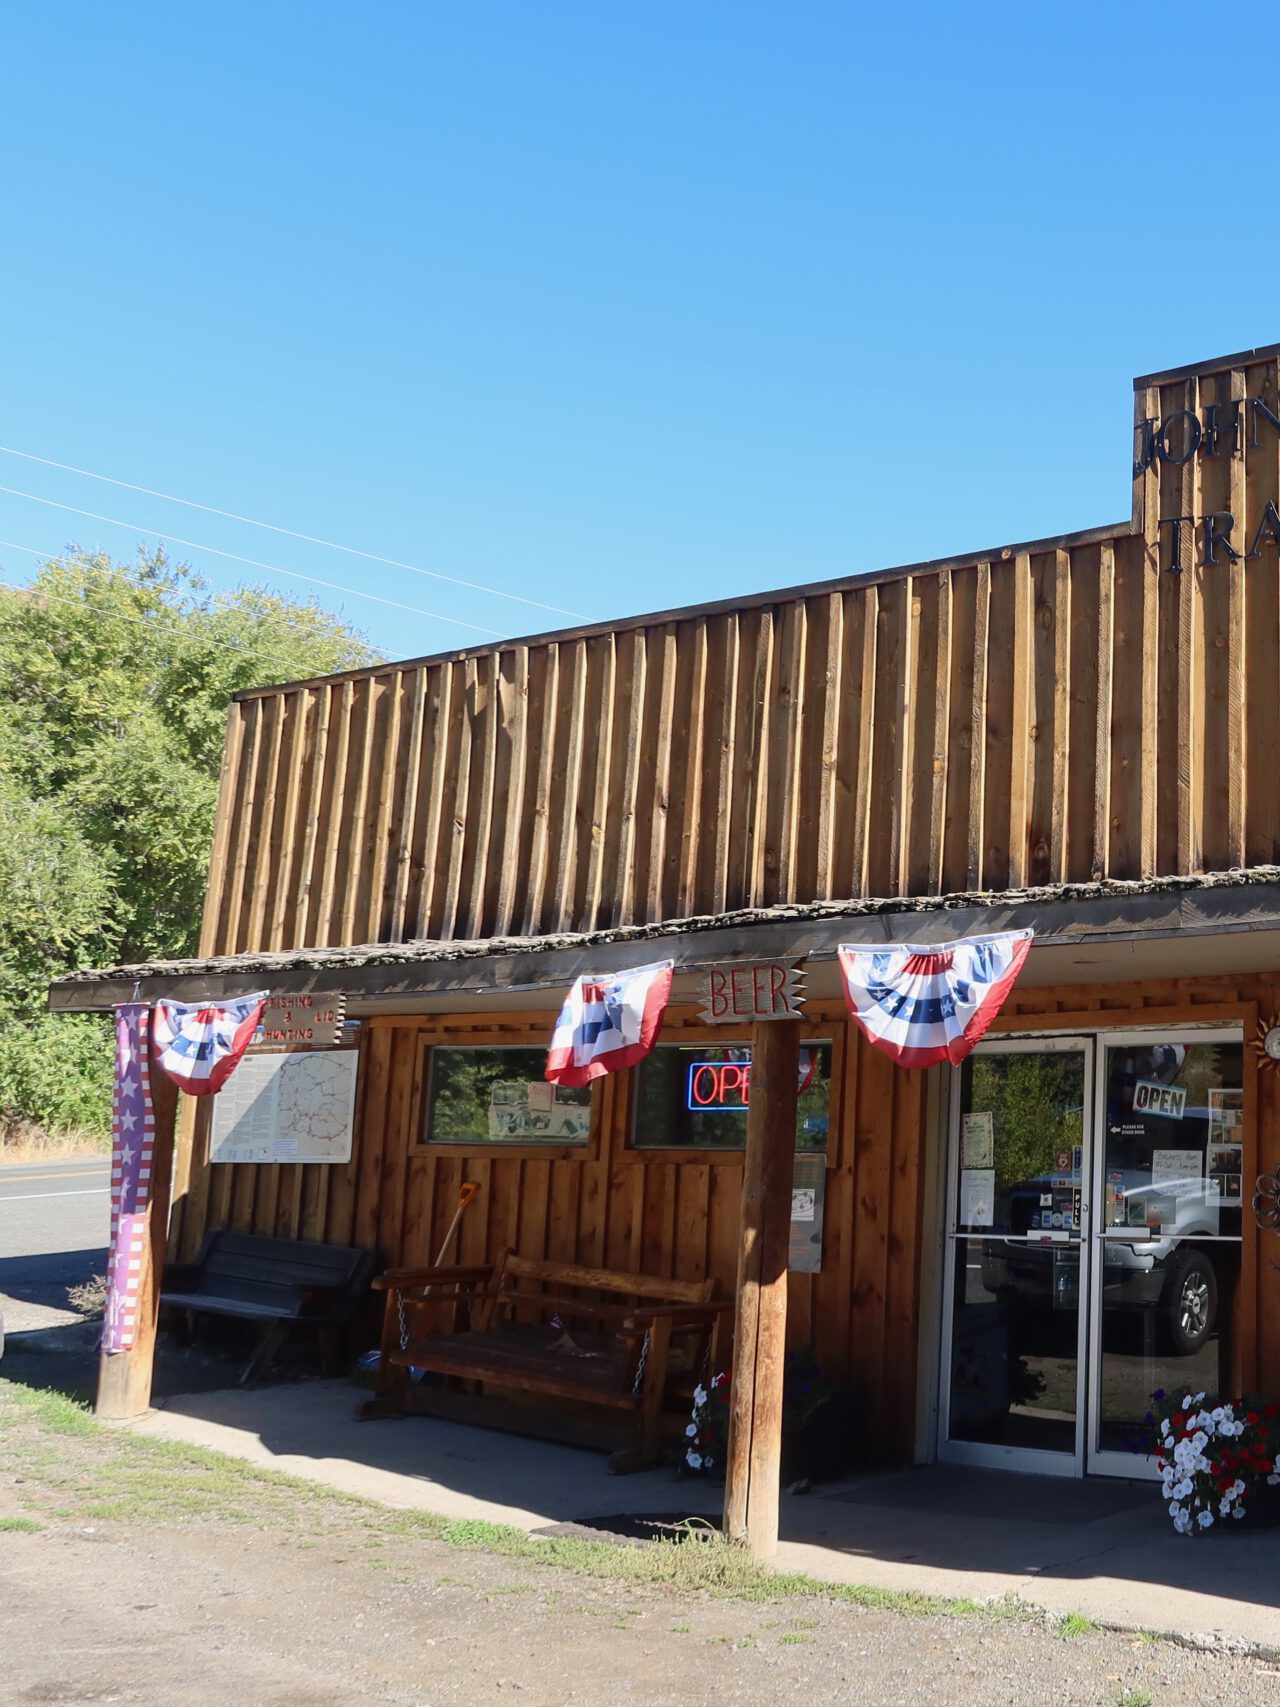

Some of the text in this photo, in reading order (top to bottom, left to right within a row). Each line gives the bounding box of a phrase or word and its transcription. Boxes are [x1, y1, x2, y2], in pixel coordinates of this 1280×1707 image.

[269, 995, 313, 1009] FISHING
[710, 964, 790, 1017] BEER
[265, 1027, 313, 1041] HUNTING
[693, 1065, 752, 1104] OP
[1136, 1085, 1184, 1116] OPEN
